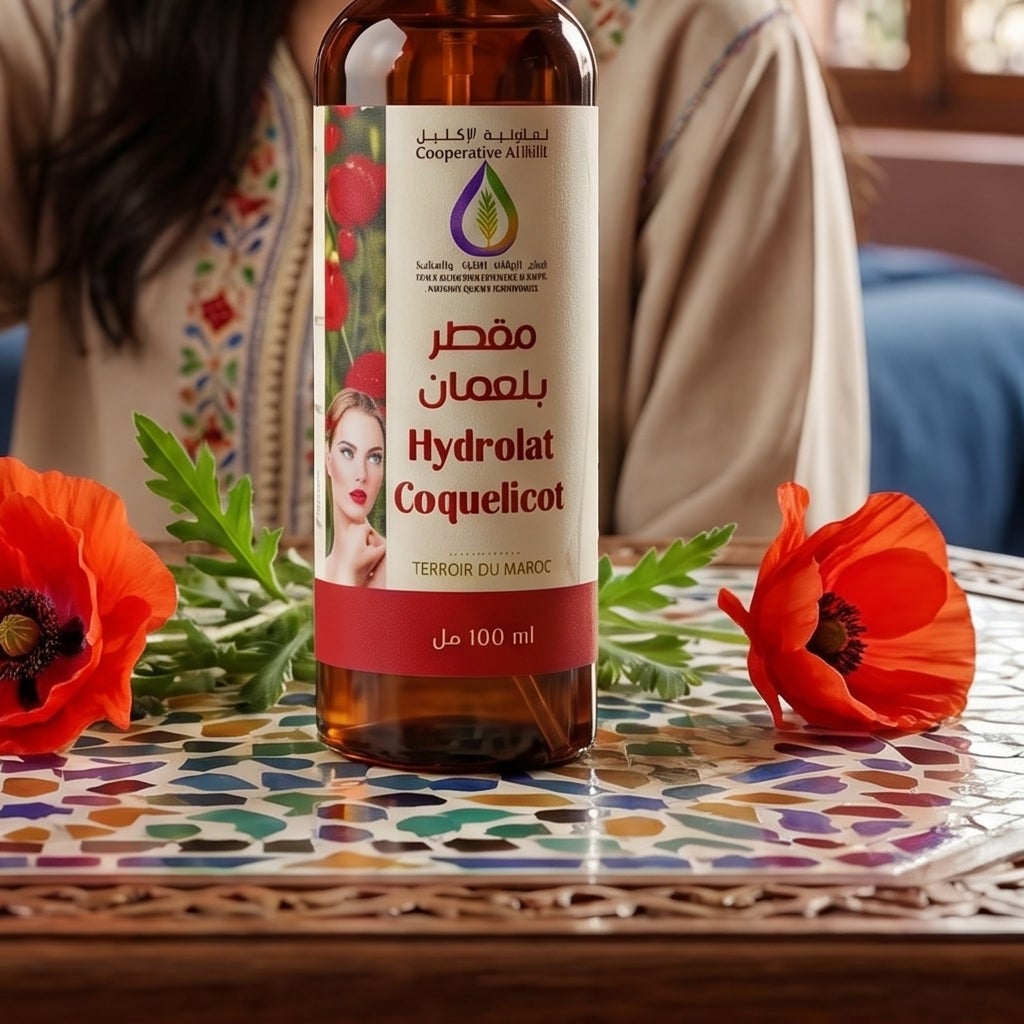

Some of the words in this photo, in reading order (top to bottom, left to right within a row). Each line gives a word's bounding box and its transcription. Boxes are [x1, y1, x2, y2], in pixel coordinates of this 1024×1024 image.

[416, 146, 502, 163] Cooperative
[428, 318, 537, 360] مقطر
[418, 369, 548, 410] بلعمان
[408, 428, 554, 471] Hydrolat
[394, 480, 565, 524] Coquelicot
[412, 561, 474, 577] TERROIR
[478, 562, 500, 577] DU
[504, 559, 552, 576] MAROC
[432, 627, 462, 650] مل
[469, 628, 505, 646] 100
[513, 625, 535, 645] ml
